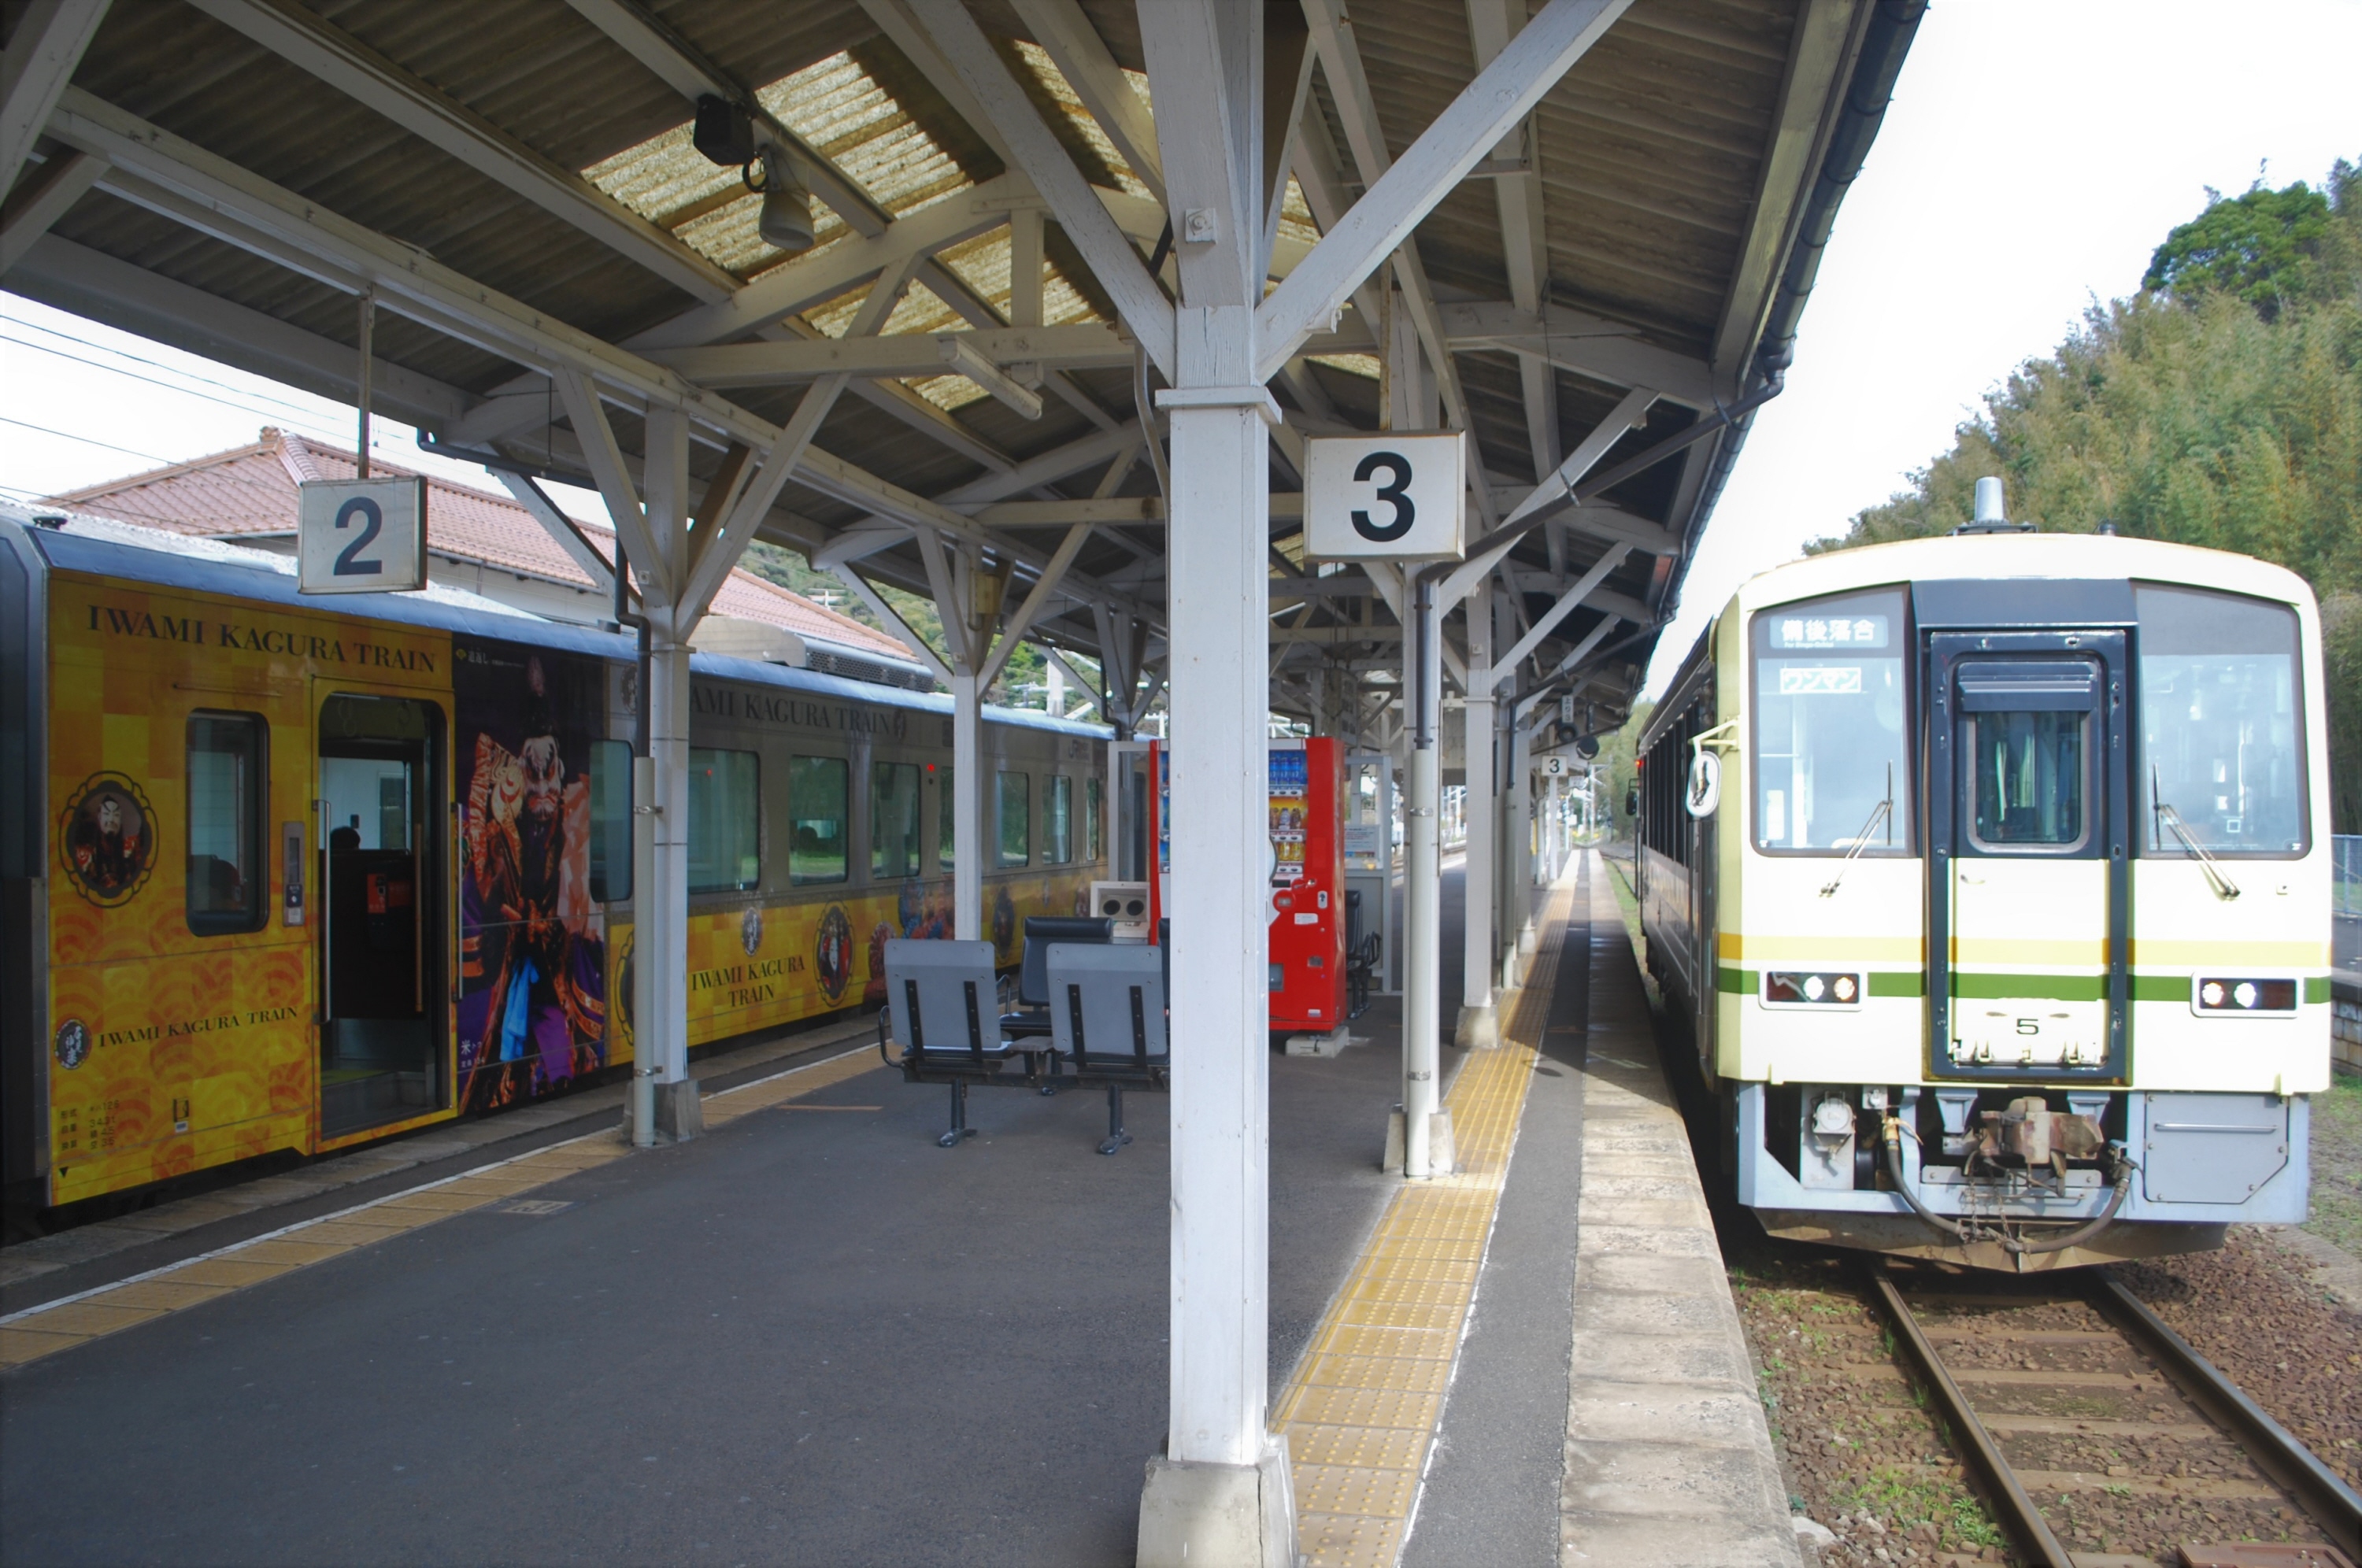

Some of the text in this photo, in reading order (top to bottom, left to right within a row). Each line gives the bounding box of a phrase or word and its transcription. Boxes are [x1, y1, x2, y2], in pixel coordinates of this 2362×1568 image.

[1350, 451, 1416, 543] 3
[333, 496, 383, 576] 2
[88, 605, 435, 673] IWAMI KAGURA TRAIN
[1782, 619, 1875, 642] 備後落合
[1783, 670, 1858, 690] ワンマン
[690, 685, 735, 717] AMI
[745, 693, 831, 729] KAGURA
[835, 707, 893, 735] TRAIN
[1549, 758, 1560, 773] 3
[692, 955, 805, 991] IWAMI KAGURA
[727, 982, 776, 1008] TRAIN
[98, 1005, 298, 1048] IWAMI KAGURA TRAIN
[2016, 1019, 2039, 1035] 5
